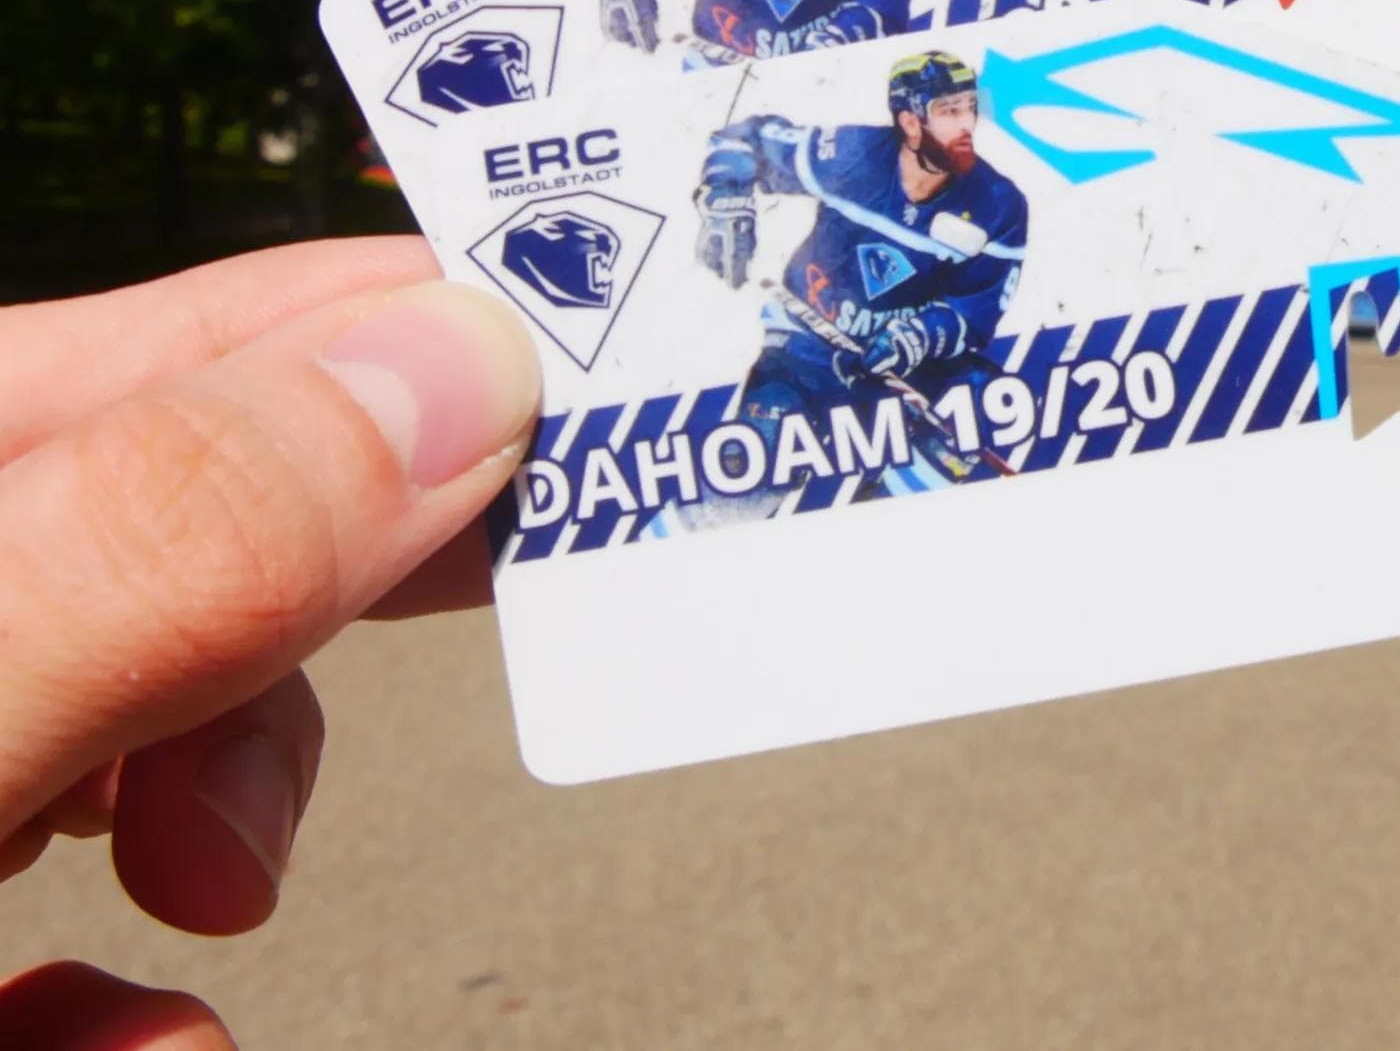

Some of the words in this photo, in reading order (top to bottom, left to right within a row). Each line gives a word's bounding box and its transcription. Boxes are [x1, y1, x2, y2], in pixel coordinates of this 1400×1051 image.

[483, 128, 621, 183] ERC
[489, 166, 623, 200] INGOLSTADT
[514, 398, 911, 529] DAHOAM
[934, 351, 1176, 453] 19/20
